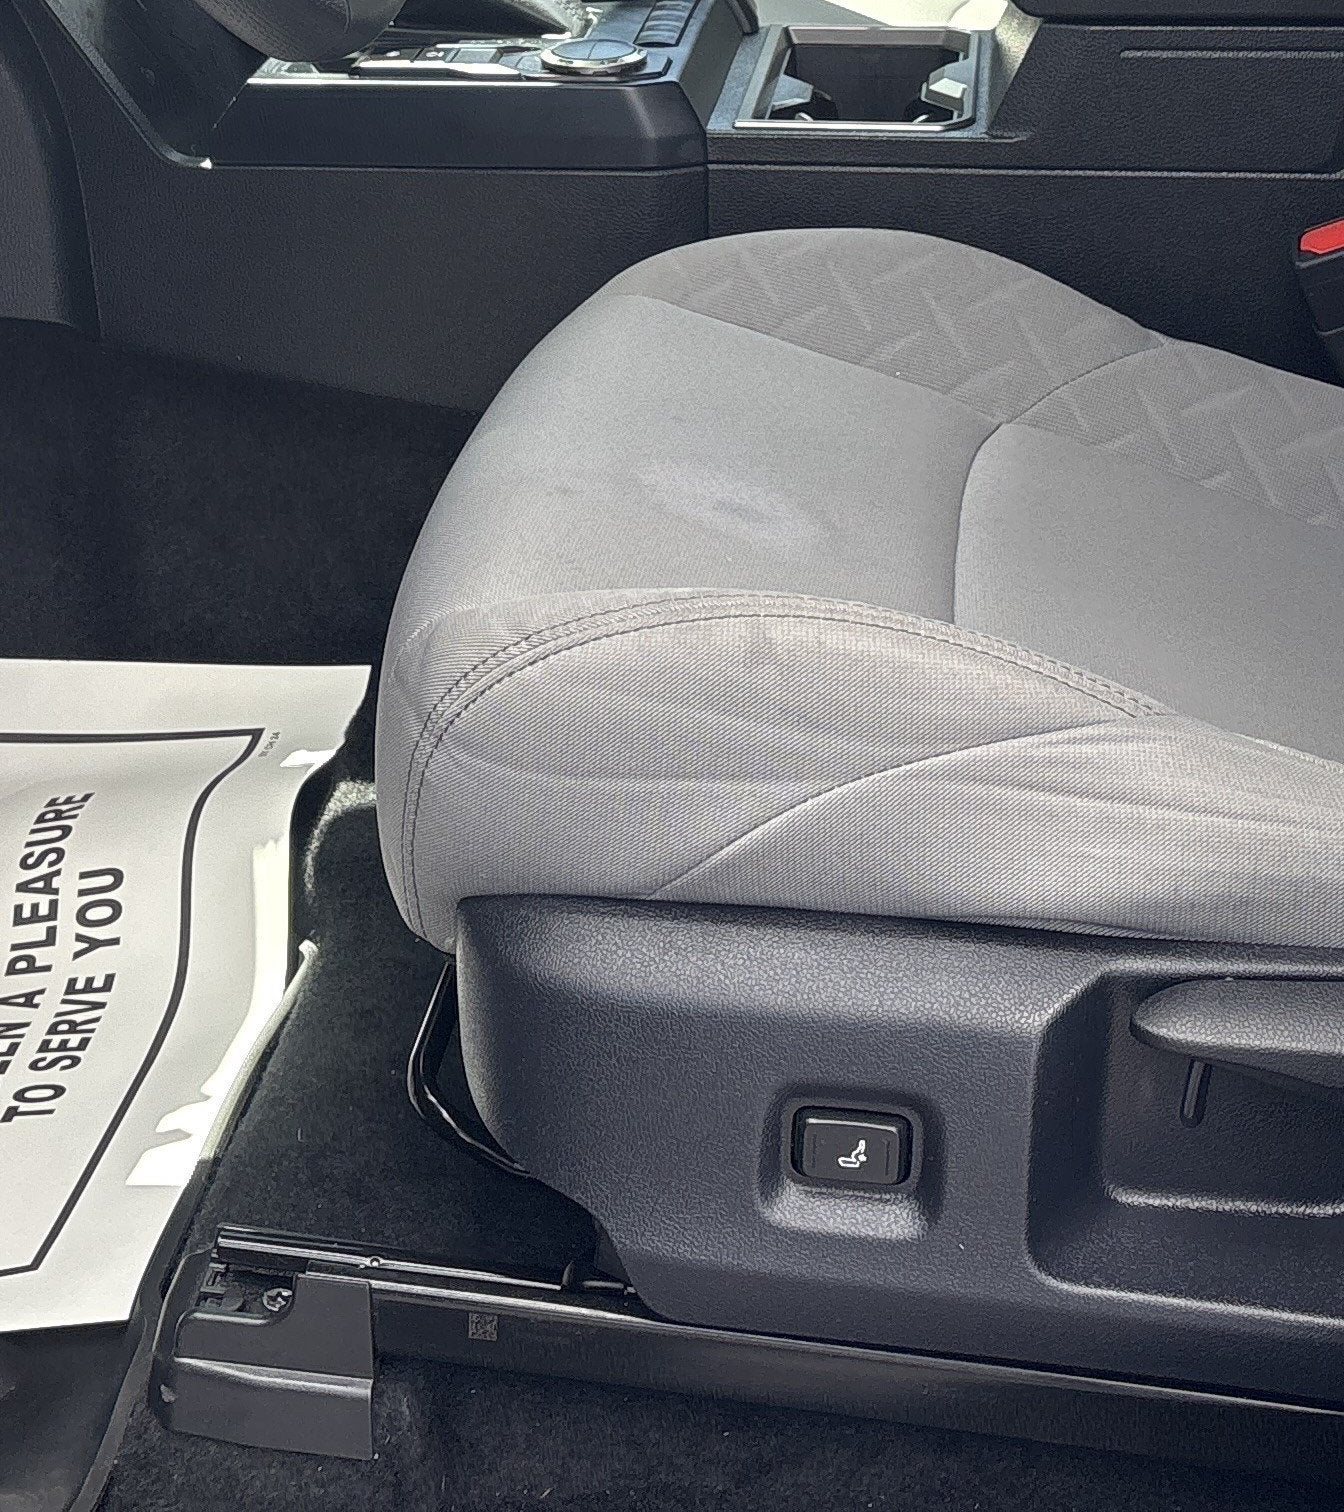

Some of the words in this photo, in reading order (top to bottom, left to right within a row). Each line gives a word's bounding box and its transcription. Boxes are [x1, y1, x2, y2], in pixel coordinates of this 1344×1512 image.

[4, 792, 95, 977] PLEASURE
[72, 868, 124, 961] YOU
[28, 973, 116, 1071] SERVE
[0, 1084, 66, 1123] TO
